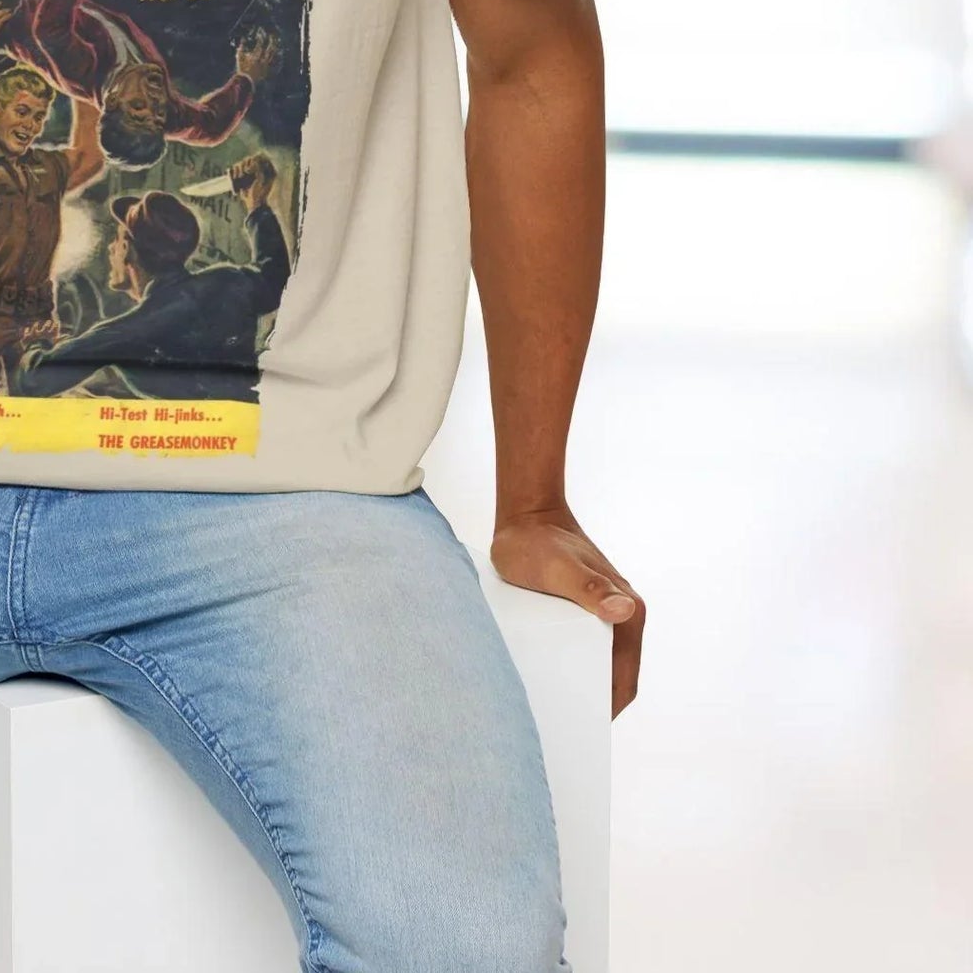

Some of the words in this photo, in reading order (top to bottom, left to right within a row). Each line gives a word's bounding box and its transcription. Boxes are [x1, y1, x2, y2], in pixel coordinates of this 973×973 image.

[100, 406, 148, 422] Hi-Test
[154, 407, 223, 425] Hi-jinks...
[98, 433, 124, 449] THE
[130, 434, 238, 451] GREASEMONKEY
